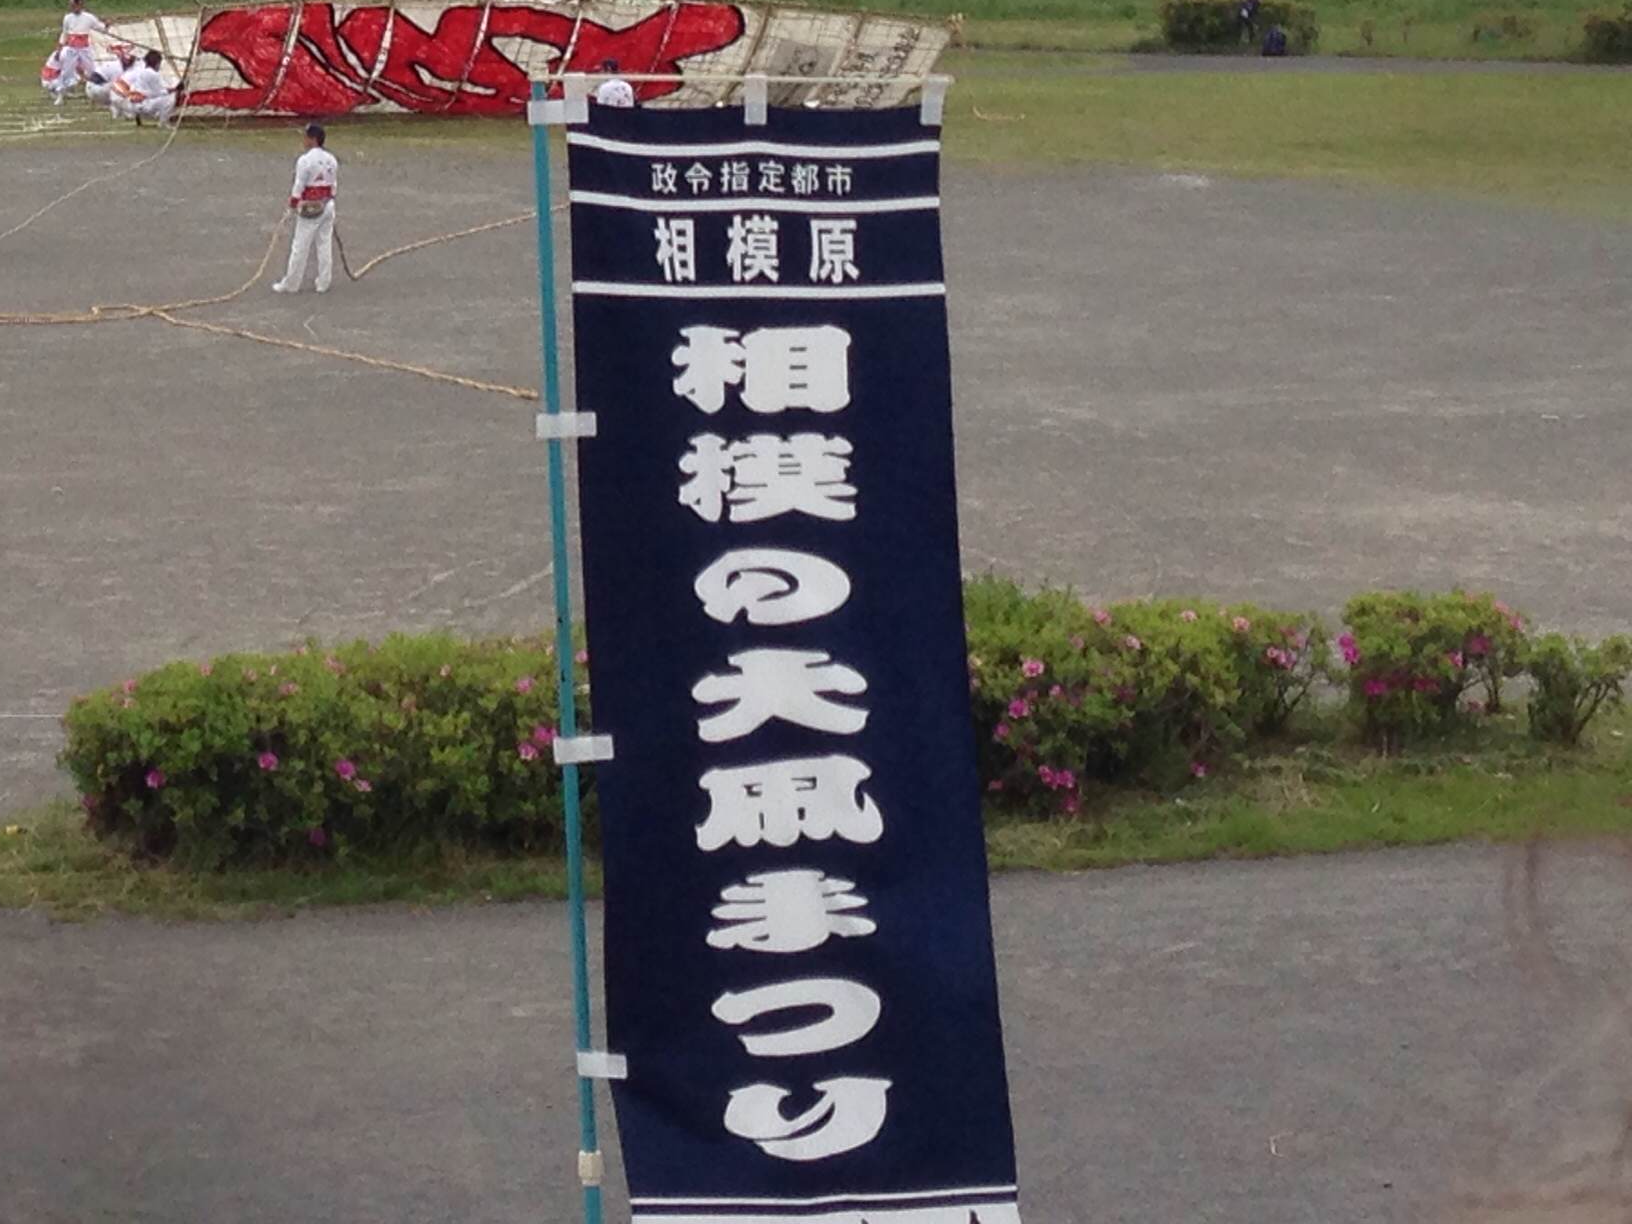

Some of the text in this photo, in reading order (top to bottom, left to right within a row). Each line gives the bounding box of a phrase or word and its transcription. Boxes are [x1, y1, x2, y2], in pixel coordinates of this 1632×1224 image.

[651, 160, 854, 196] 政令指定都市
[654, 214, 860, 284] 相模原
[671, 324, 893, 1161] 相模の大凧まつり
